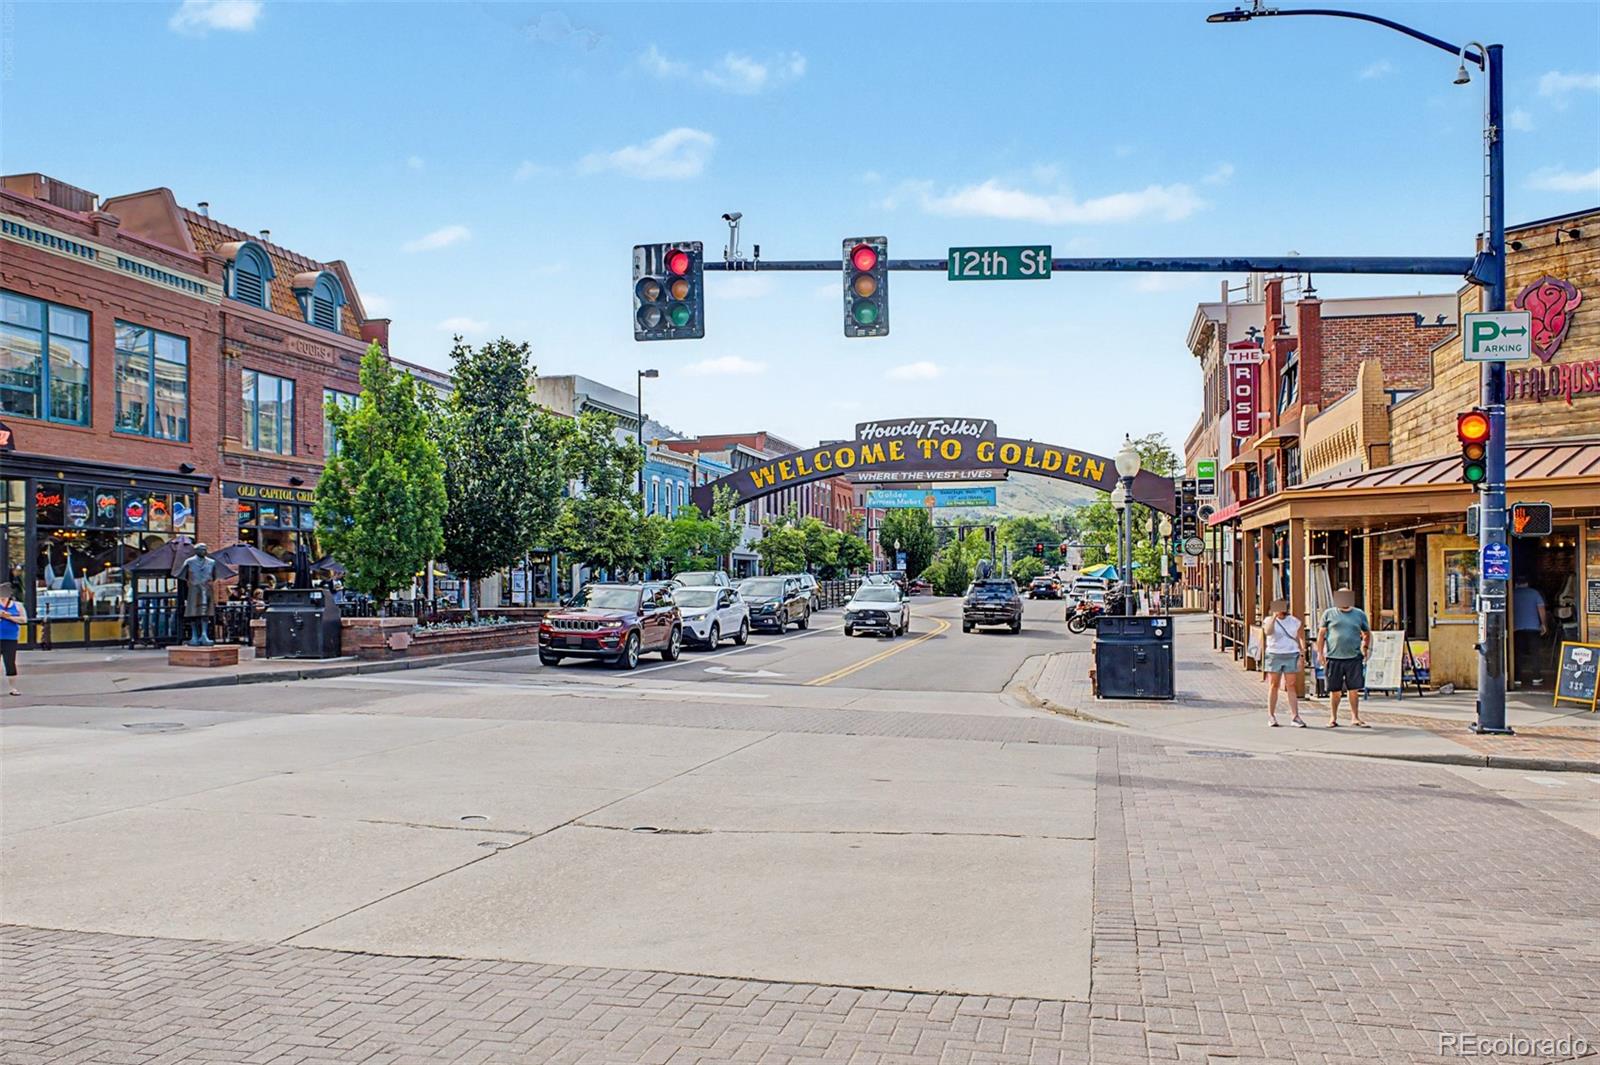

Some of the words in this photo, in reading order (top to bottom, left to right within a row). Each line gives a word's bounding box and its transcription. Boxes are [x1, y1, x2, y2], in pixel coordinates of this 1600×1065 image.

[952, 250, 1008, 276] 12th
[1019, 249, 1047, 275] St
[296, 340, 327, 359] COORS
[1229, 352, 1260, 361] THE
[1505, 365, 1560, 403] FFALO
[1236, 367, 1252, 432] ROSE
[860, 420, 925, 440] Howdy
[926, 419, 988, 439] Folks!
[750, 440, 905, 489] WELCOME
[916, 439, 962, 460] TO
[976, 440, 1106, 482] GOLDEN
[858, 472, 898, 481] WHERE
[899, 472, 924, 480] THE
[926, 471, 957, 480] WEST
[960, 470, 992, 479] LIVES
[237, 485, 256, 497] OLD
[259, 487, 294, 500] CAPITOL
[296, 491, 317, 502] GRIL
[878, 490, 907, 498] Golden
